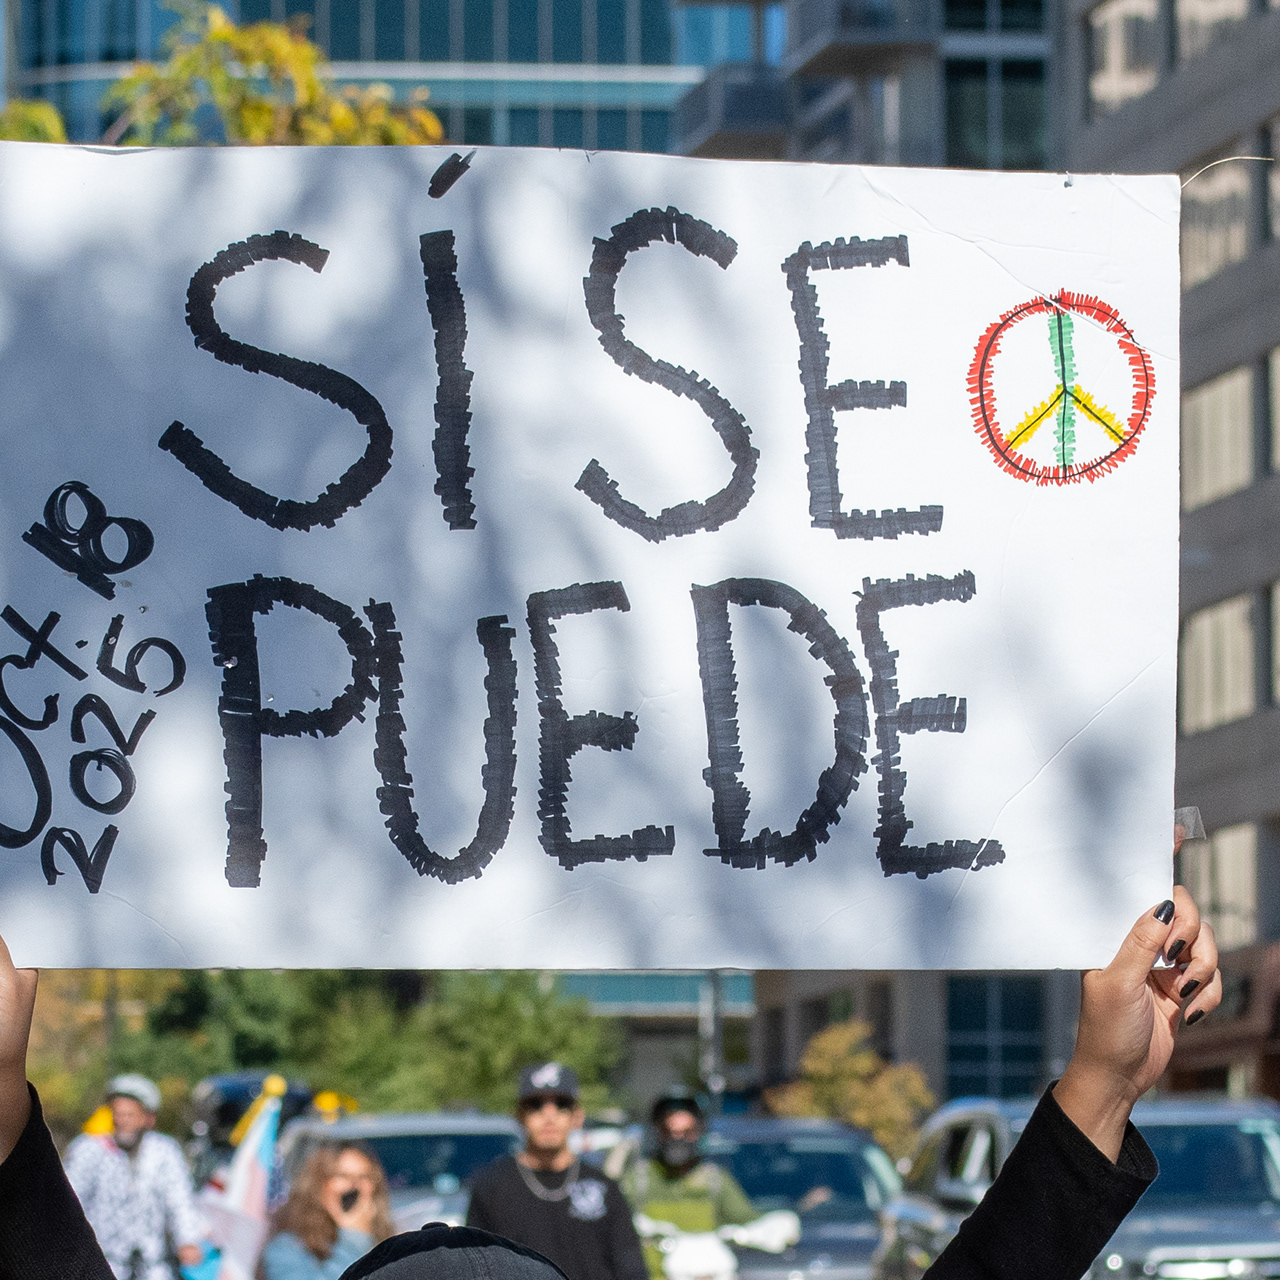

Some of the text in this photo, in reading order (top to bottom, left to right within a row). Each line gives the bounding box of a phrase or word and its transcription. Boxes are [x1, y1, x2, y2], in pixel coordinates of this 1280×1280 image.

[157, 151, 945, 543] SÍ SE
[21, 480, 155, 601] 18
[41, 614, 187, 894] 2025
[204, 568, 1007, 889] PUEDE
